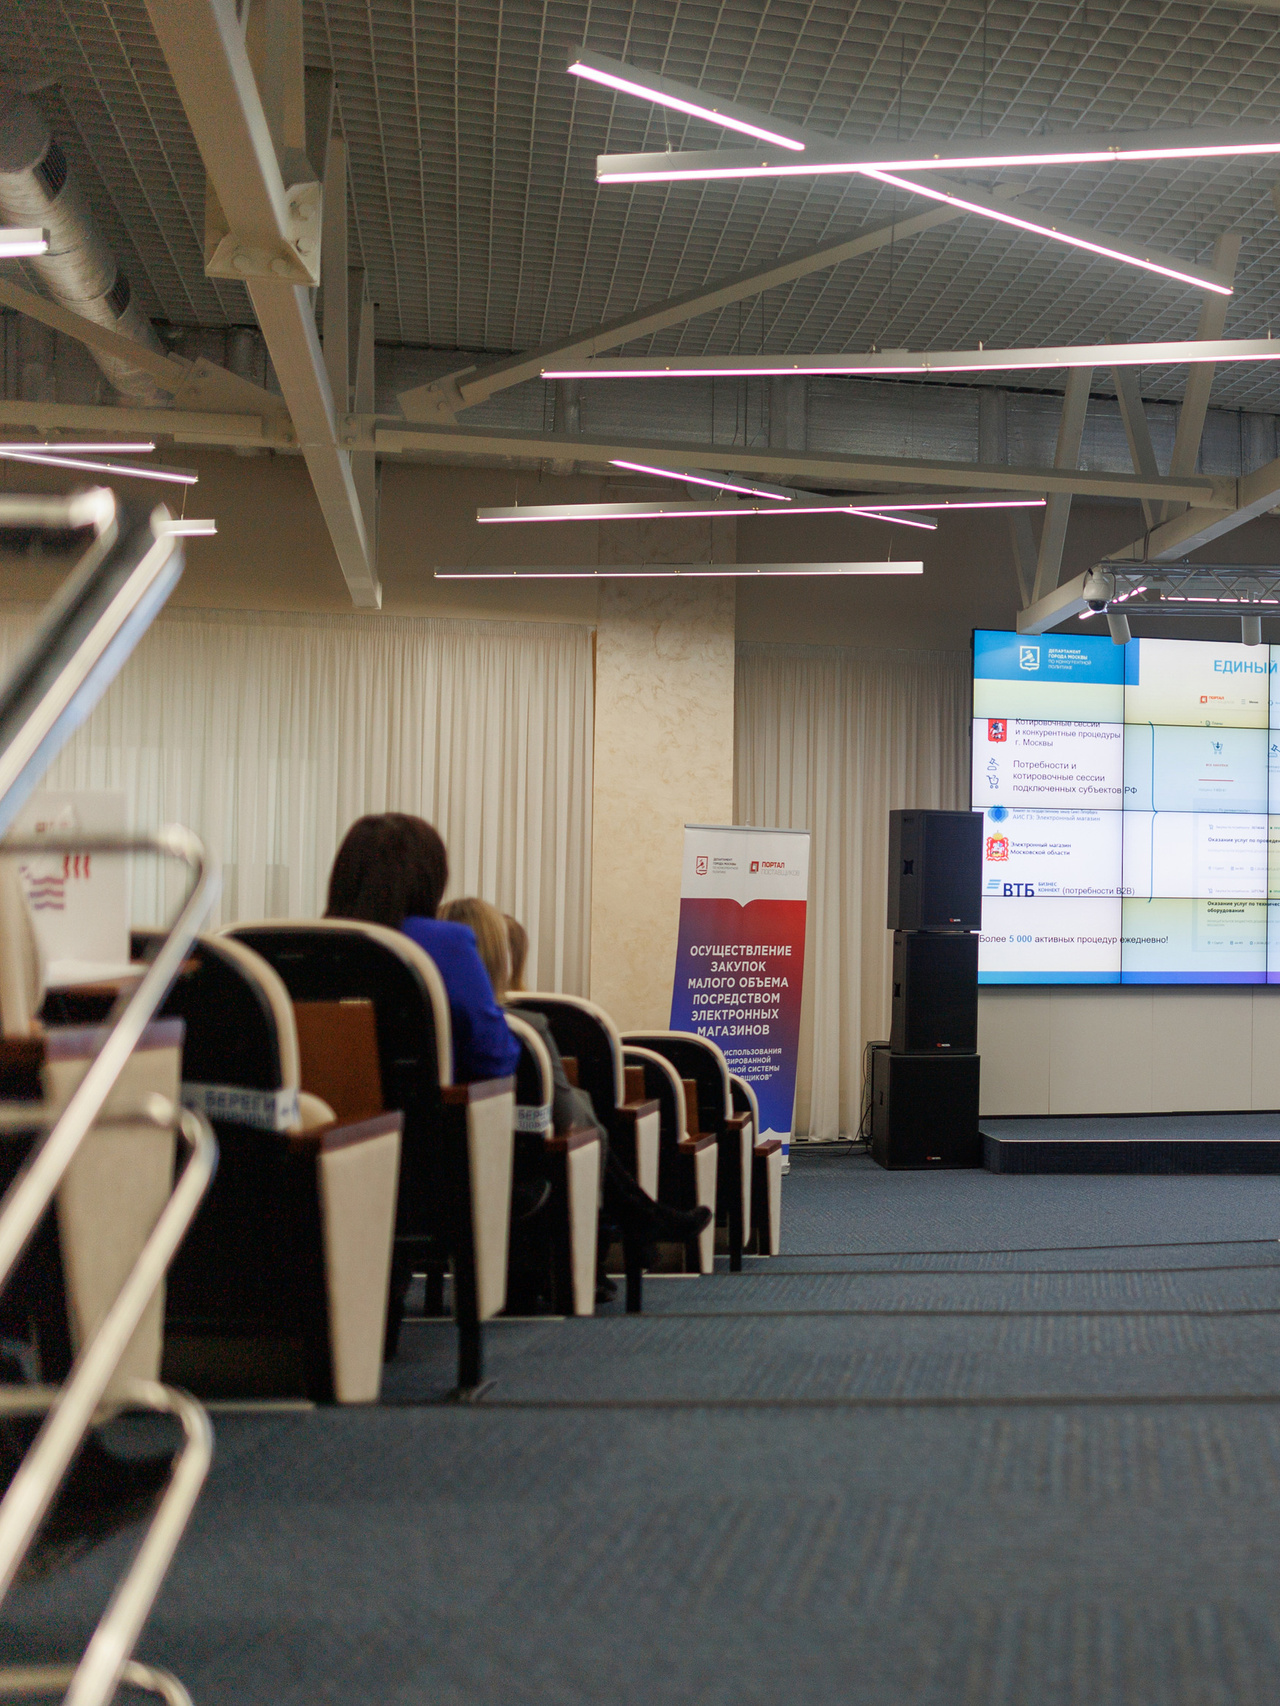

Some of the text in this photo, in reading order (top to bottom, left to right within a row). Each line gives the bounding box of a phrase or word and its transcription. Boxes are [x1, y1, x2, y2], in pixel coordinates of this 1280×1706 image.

[1214, 659, 1278, 673] ЕДИНЫЙ
[1015, 718, 1072, 727] Котировочные
[1022, 730, 1076, 739] конкурентные
[1078, 731, 1121, 740] процедуры
[1023, 738, 1054, 747] Москвы
[1013, 760, 1069, 771] Потребности
[1013, 772, 1105, 783] котировочные сессии
[1013, 785, 1138, 796] подключенных субъектов РФ
[1003, 883, 1035, 897] ВТБ
[1062, 887, 1114, 896] (потребности
[979, 935, 1007, 943] Более
[1009, 935, 1014, 943] 5
[1017, 935, 1032, 943] 000
[1077, 936, 1117, 945] процедур
[1120, 936, 1169, 945] ежедневно!
[690, 945, 792, 957] ОСУЩЕСТВЛЕНИЕ
[710, 961, 766, 972] ЗАКУПОК
[688, 977, 789, 989] МАЛОГО ОБЪЕМА
[693, 993, 780, 1006] ПОСРЕДСТВОМ
[691, 1008, 779, 1021] ЭЛЕКТРОННЫХ
[697, 1024, 770, 1037] МАГАЗИНОВ
